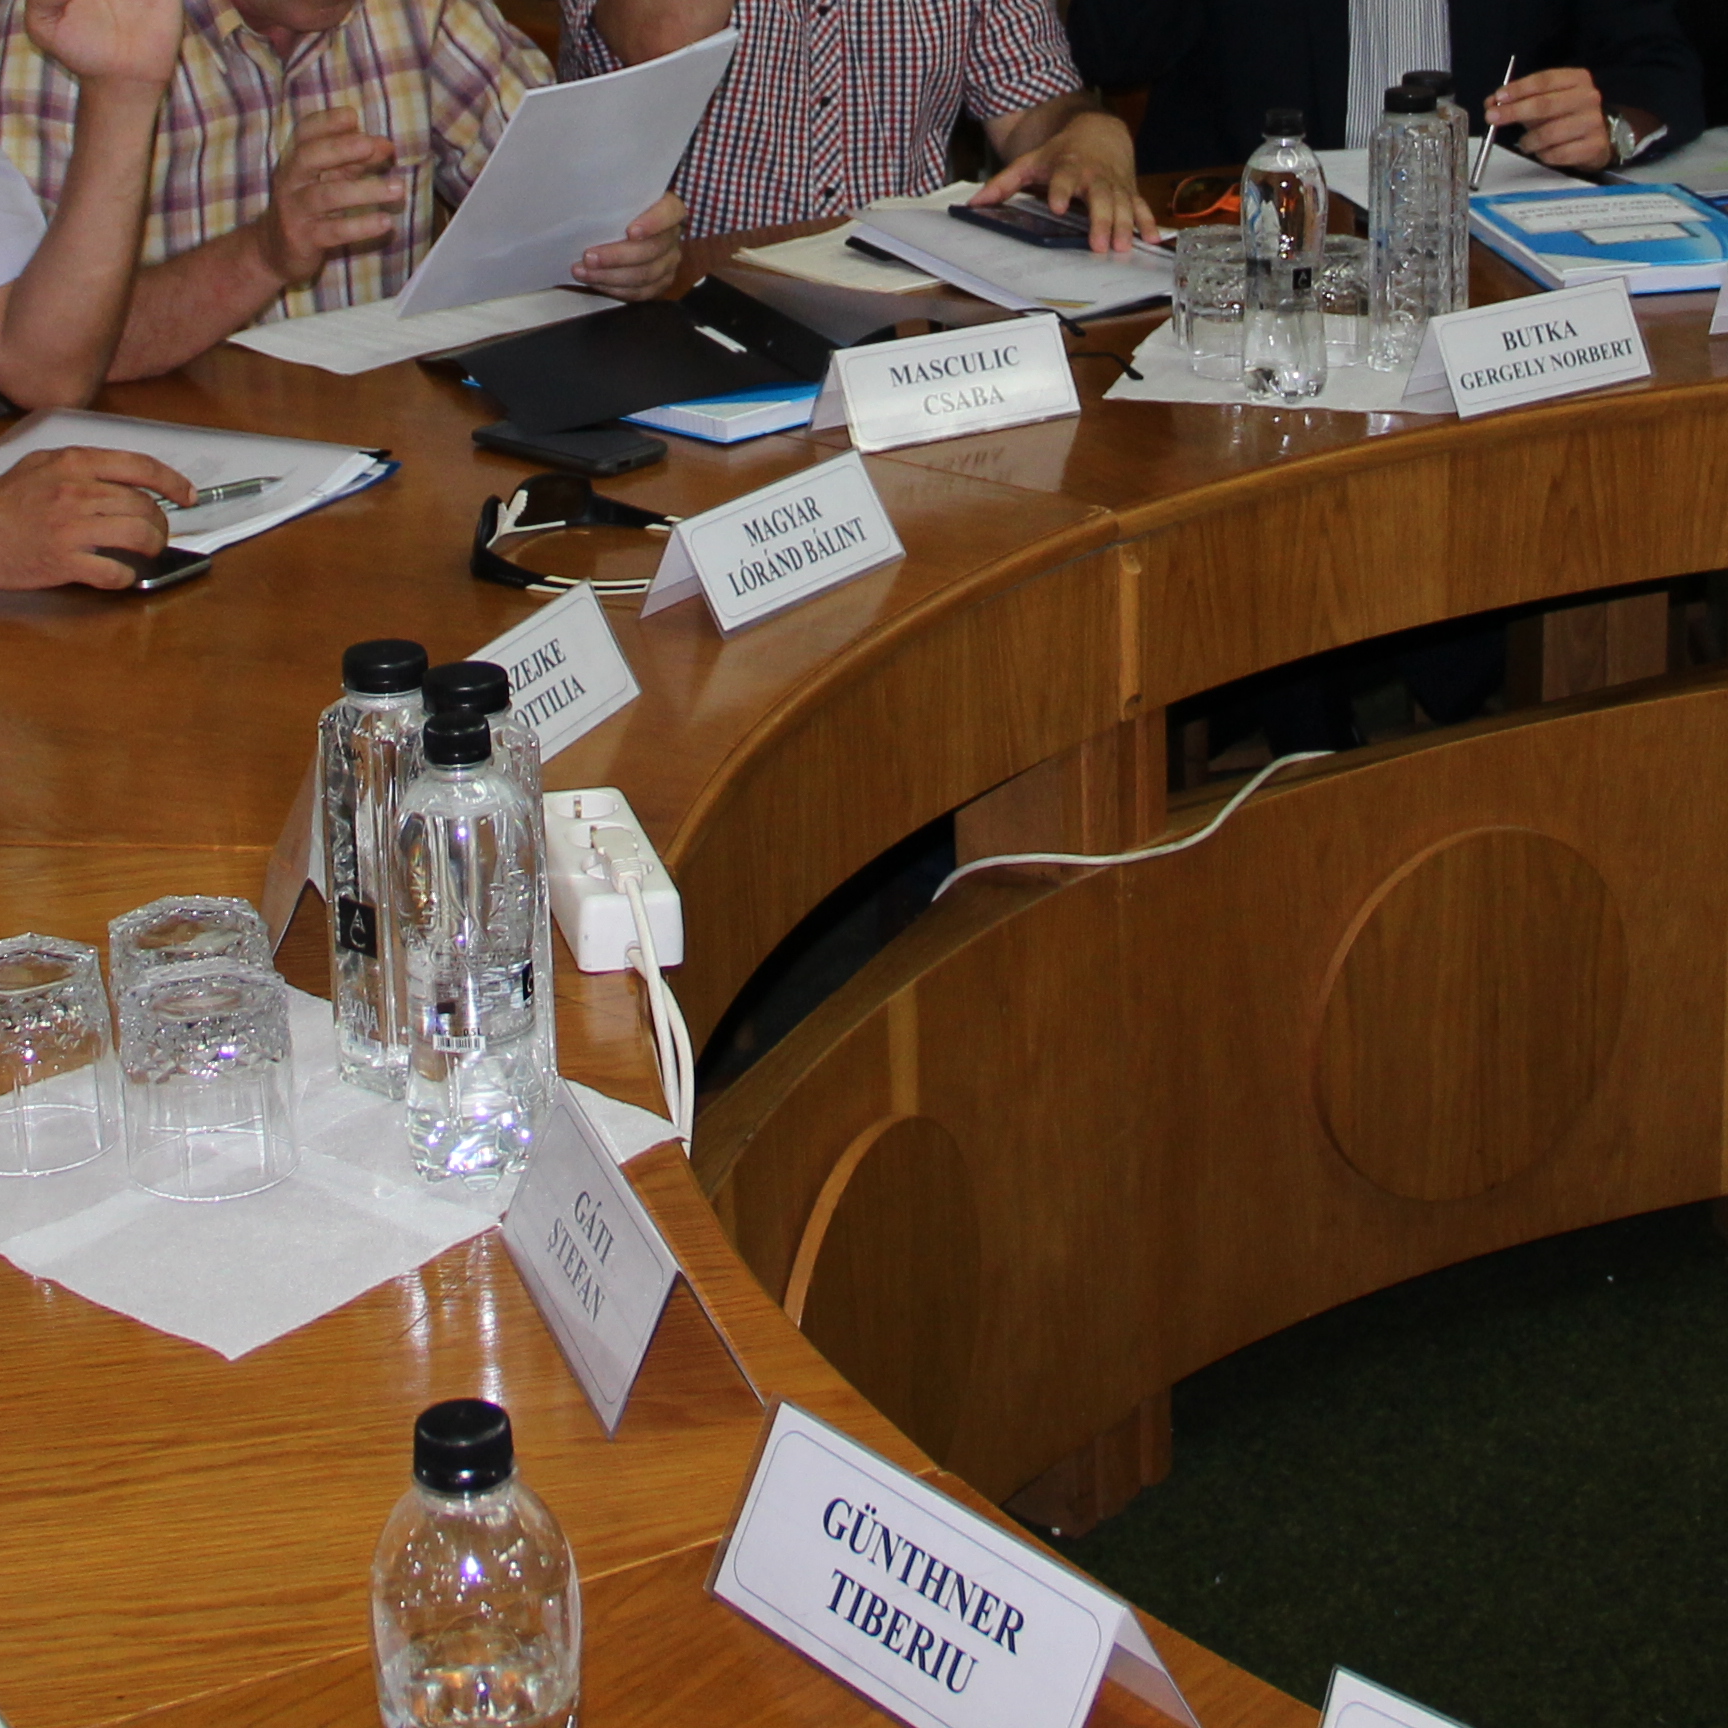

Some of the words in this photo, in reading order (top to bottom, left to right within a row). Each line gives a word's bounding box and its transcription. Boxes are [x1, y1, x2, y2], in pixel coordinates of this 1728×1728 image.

[1501, 320, 1578, 352] BUTKA
[888, 345, 1021, 388] MASCULIC
[1459, 356, 1547, 391] GERGELY
[1549, 338, 1635, 371] NORBERT
[923, 384, 1006, 416] CSABA
[742, 495, 824, 548] MAGYAR
[727, 550, 804, 599] LÓRÁND
[801, 516, 868, 565] BÁLINT
[574, 1191, 615, 1267] GÁTI
[823, 1497, 1025, 1656] GÜNTHNER
[826, 1568, 979, 1695] TIBERIU
